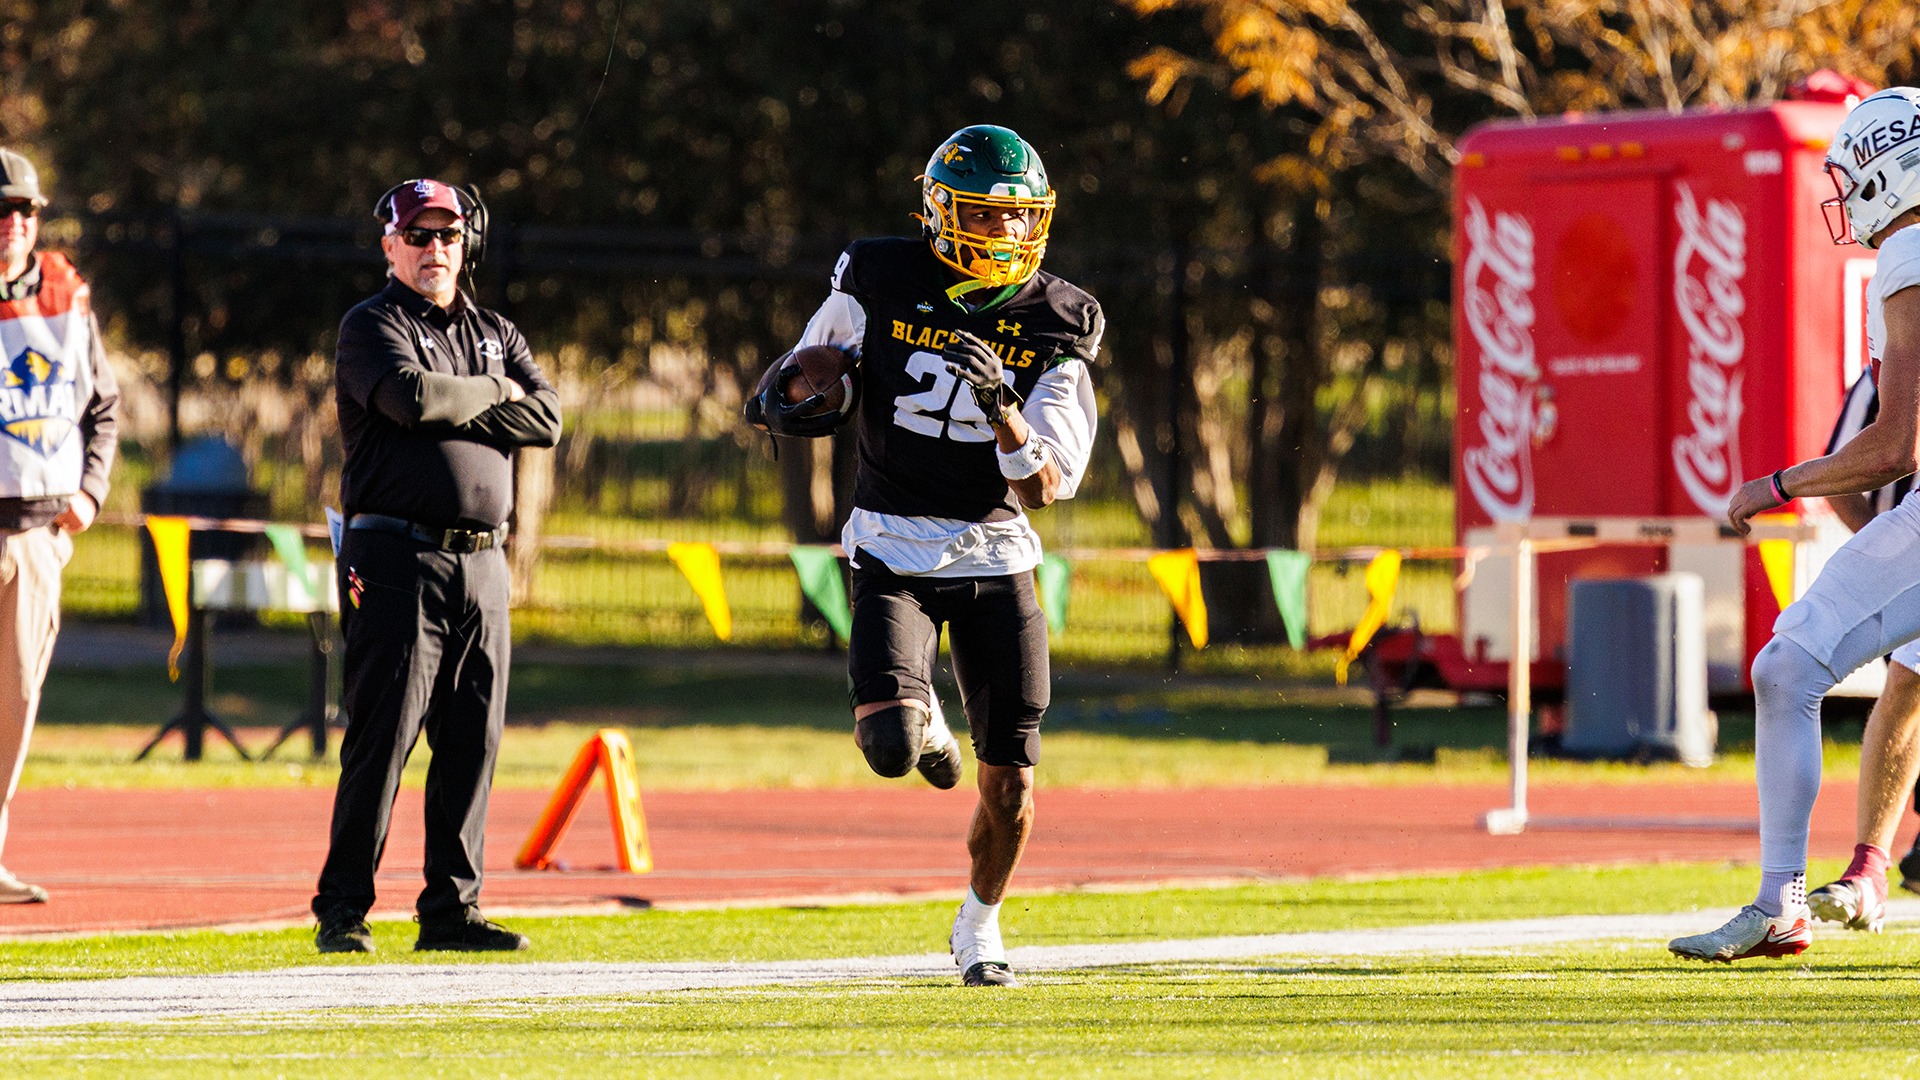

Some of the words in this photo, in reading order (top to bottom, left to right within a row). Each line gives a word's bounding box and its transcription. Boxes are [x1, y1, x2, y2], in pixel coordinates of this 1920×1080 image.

[980, 338, 1036, 368] LLS
[1463, 194, 1536, 525] Coca-Cola
[1672, 180, 1746, 517] Coca-Cola
